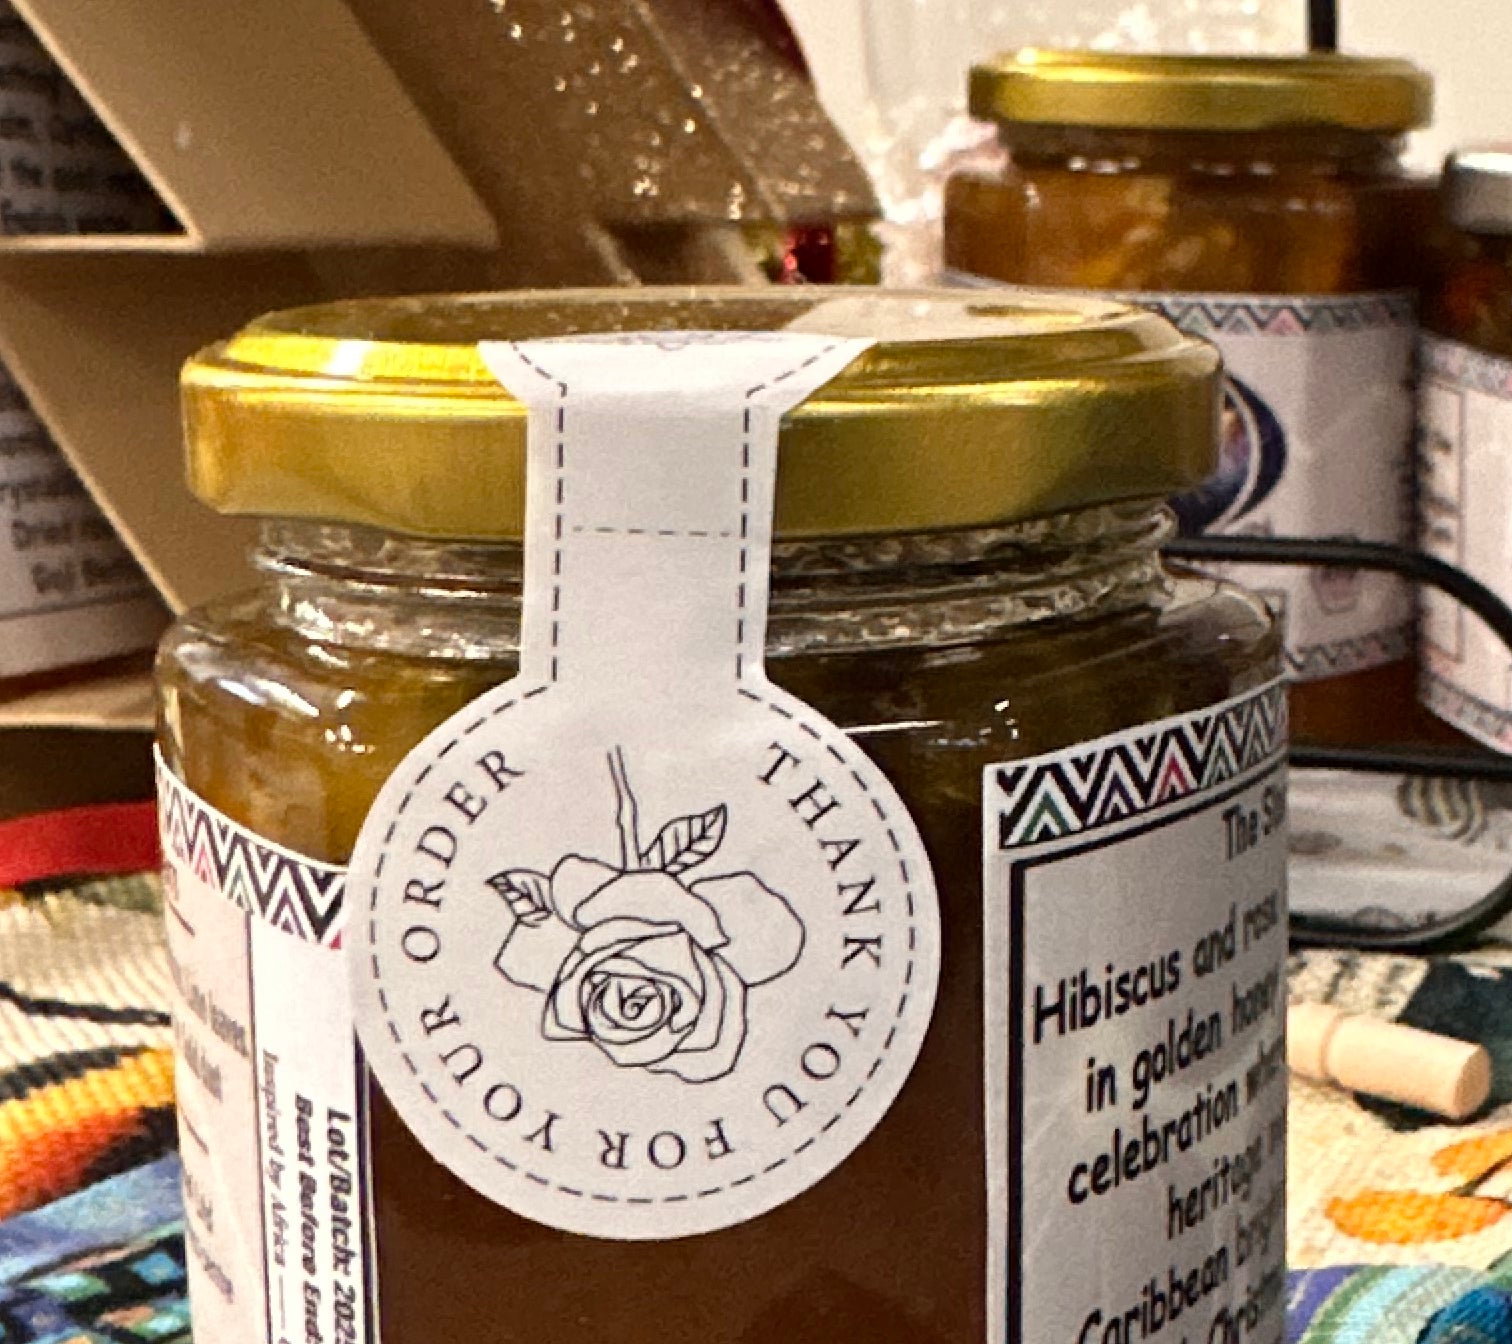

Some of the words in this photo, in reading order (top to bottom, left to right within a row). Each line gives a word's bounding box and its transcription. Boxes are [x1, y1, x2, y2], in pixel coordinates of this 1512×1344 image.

[401, 748, 526, 964] ORDER
[755, 740, 883, 971] THANK
[1033, 947, 1181, 1045] Hibiscus
[1193, 902, 1236, 978] and
[420, 993, 564, 1155] YOUR
[762, 1003, 871, 1129] YOU
[1086, 1057, 1118, 1114] in
[1131, 1008, 1222, 1111] golden
[295, 1092, 317, 1168] Best
[595, 1118, 737, 1171] FOR
[1067, 1077, 1239, 1206] celebration
[299, 1171, 320, 1277] Before
